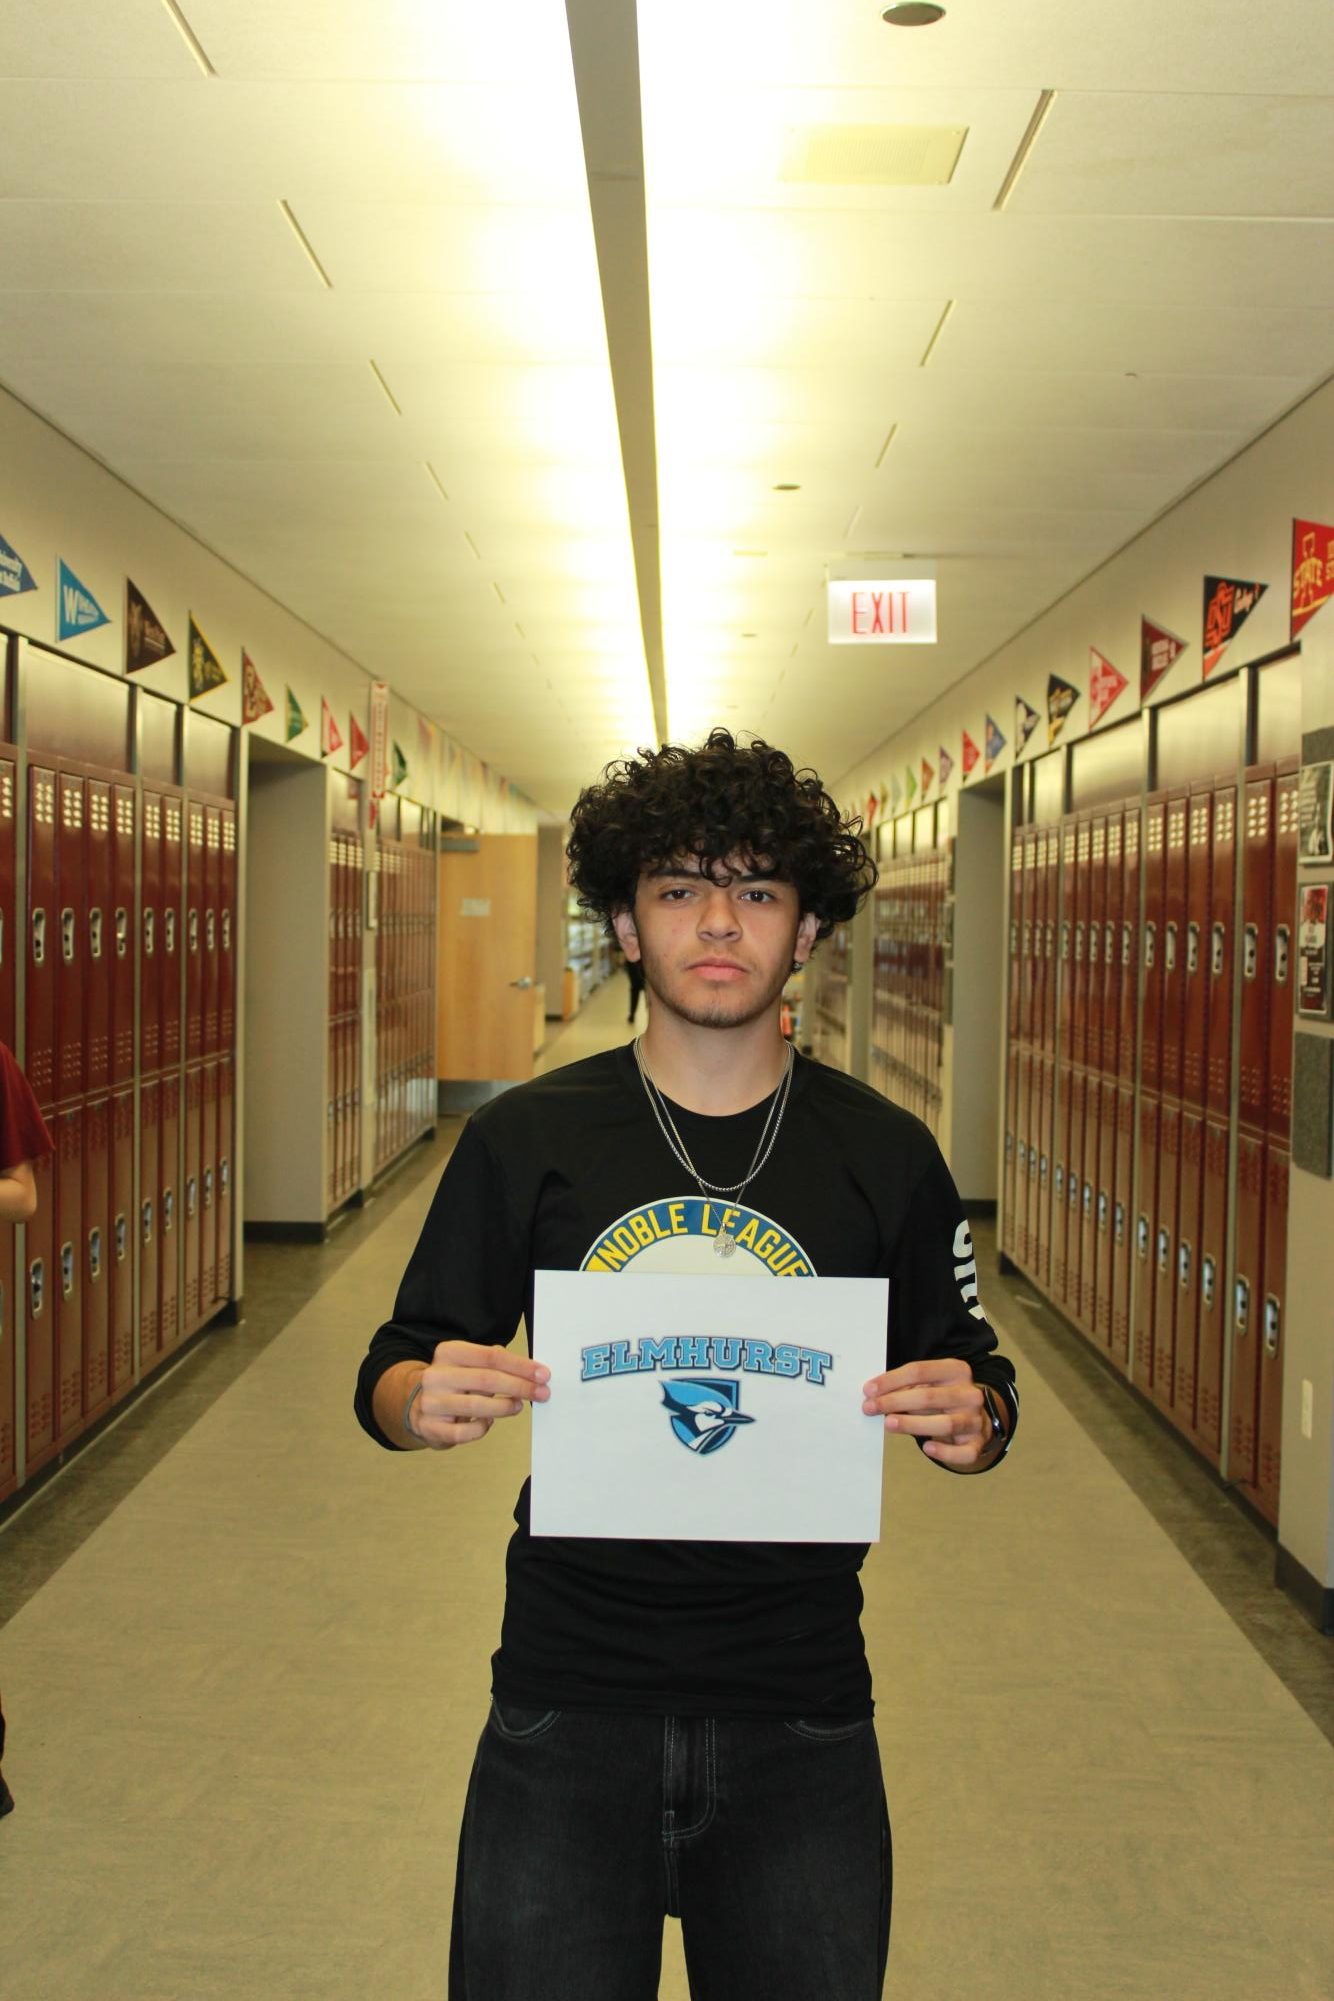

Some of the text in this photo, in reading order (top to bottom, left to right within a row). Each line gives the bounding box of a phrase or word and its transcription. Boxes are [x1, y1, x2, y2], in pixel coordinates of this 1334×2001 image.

[852, 591, 910, 634] EXIT
[596, 1203, 689, 1271] NOBLE
[580, 1336, 833, 1387] ELMHURST
